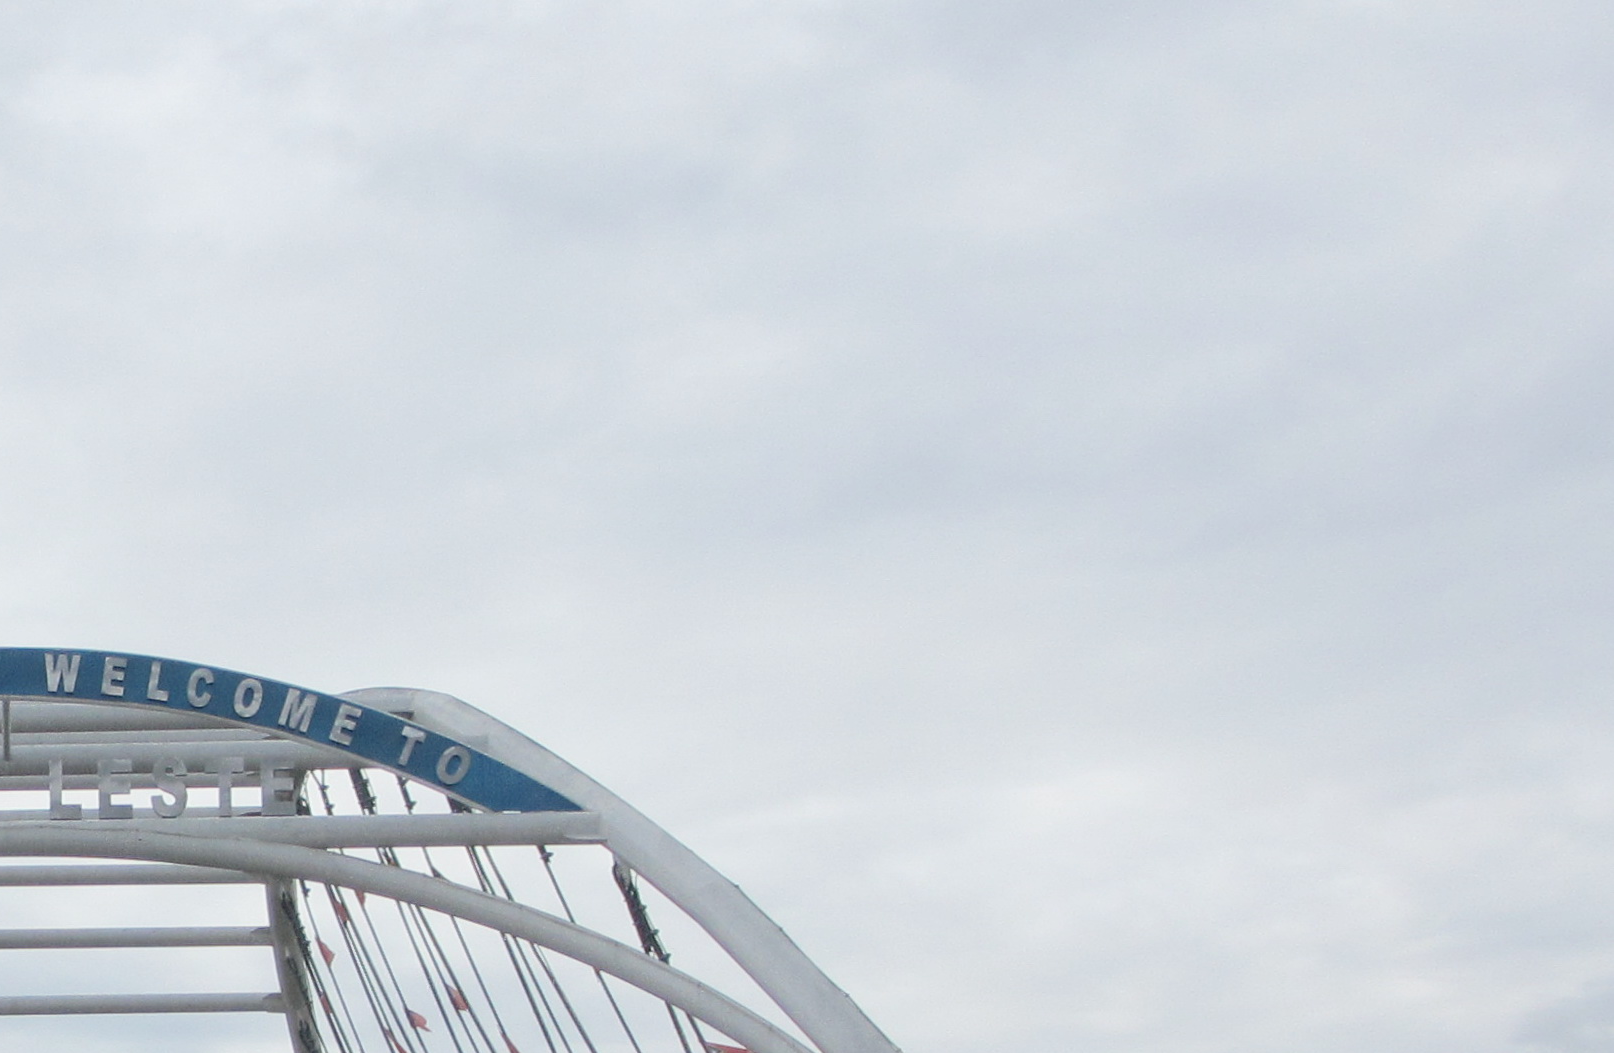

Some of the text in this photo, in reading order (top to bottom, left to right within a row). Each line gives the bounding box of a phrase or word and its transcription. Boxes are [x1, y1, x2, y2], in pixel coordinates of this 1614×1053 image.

[44, 653, 362, 746] WELCOME
[395, 727, 472, 785] TO
[48, 756, 297, 820] LESTE
